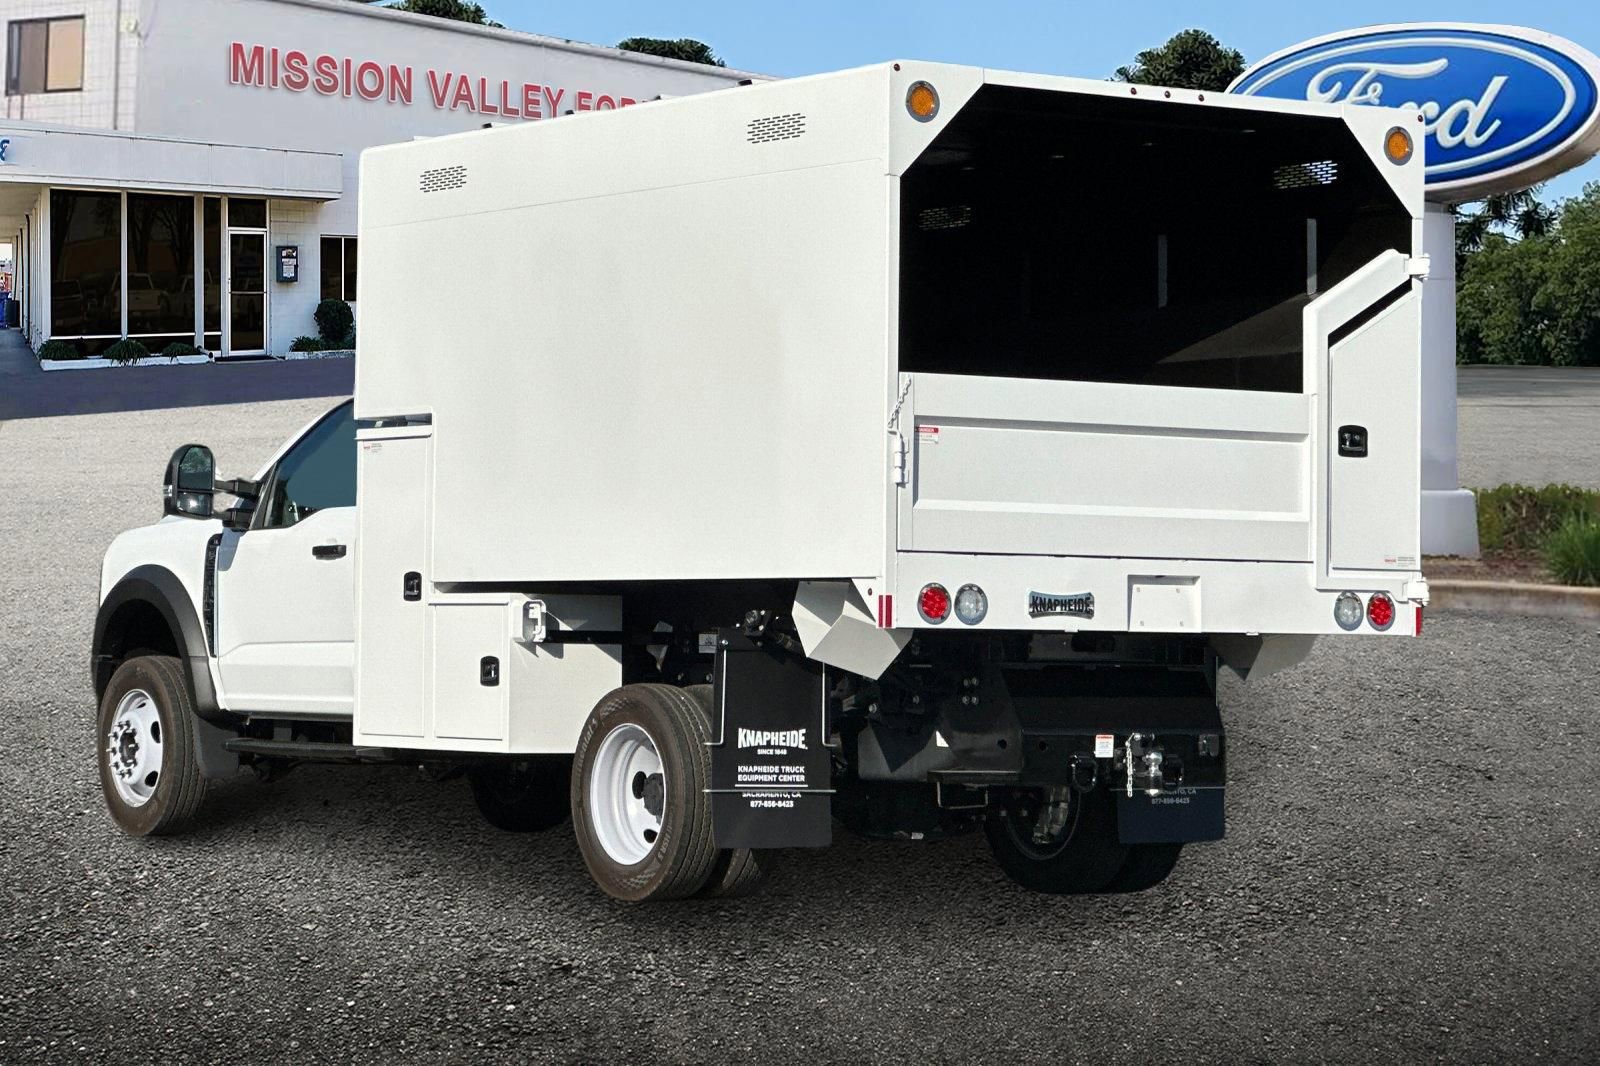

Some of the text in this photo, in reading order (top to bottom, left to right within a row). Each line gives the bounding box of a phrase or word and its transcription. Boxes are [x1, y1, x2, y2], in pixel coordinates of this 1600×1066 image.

[230, 41, 413, 104] MISSION
[427, 69, 565, 119] VALLEY
[1031, 595, 1092, 614] KNAPHEIDE
